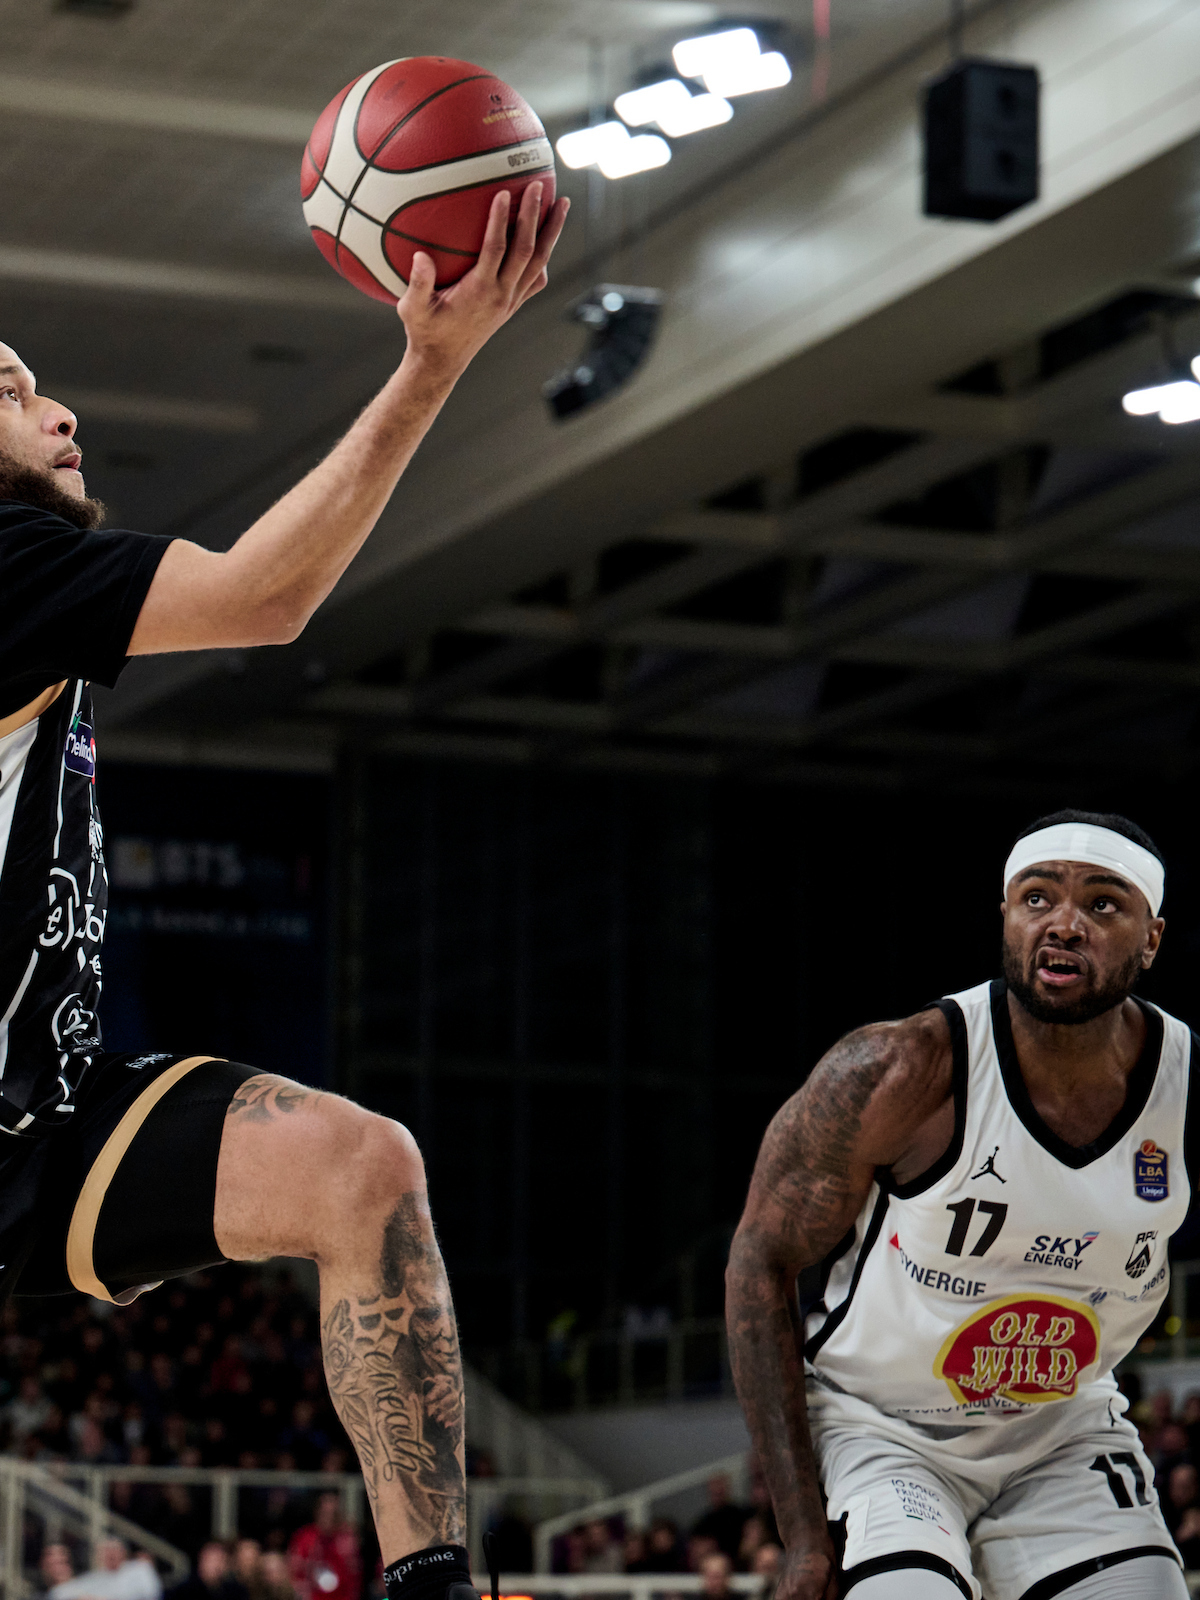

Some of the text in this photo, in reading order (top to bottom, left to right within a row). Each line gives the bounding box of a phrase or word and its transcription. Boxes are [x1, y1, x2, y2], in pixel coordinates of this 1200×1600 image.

[1138, 1166, 1165, 1177] LBA
[944, 1197, 1008, 1257] 17
[1023, 1252, 1083, 1271] ENERGY
[1030, 1235, 1093, 1257] SKY
[989, 1312, 1076, 1348] OLD
[971, 1346, 1079, 1385] WILD
[1089, 1451, 1152, 1509] 17
